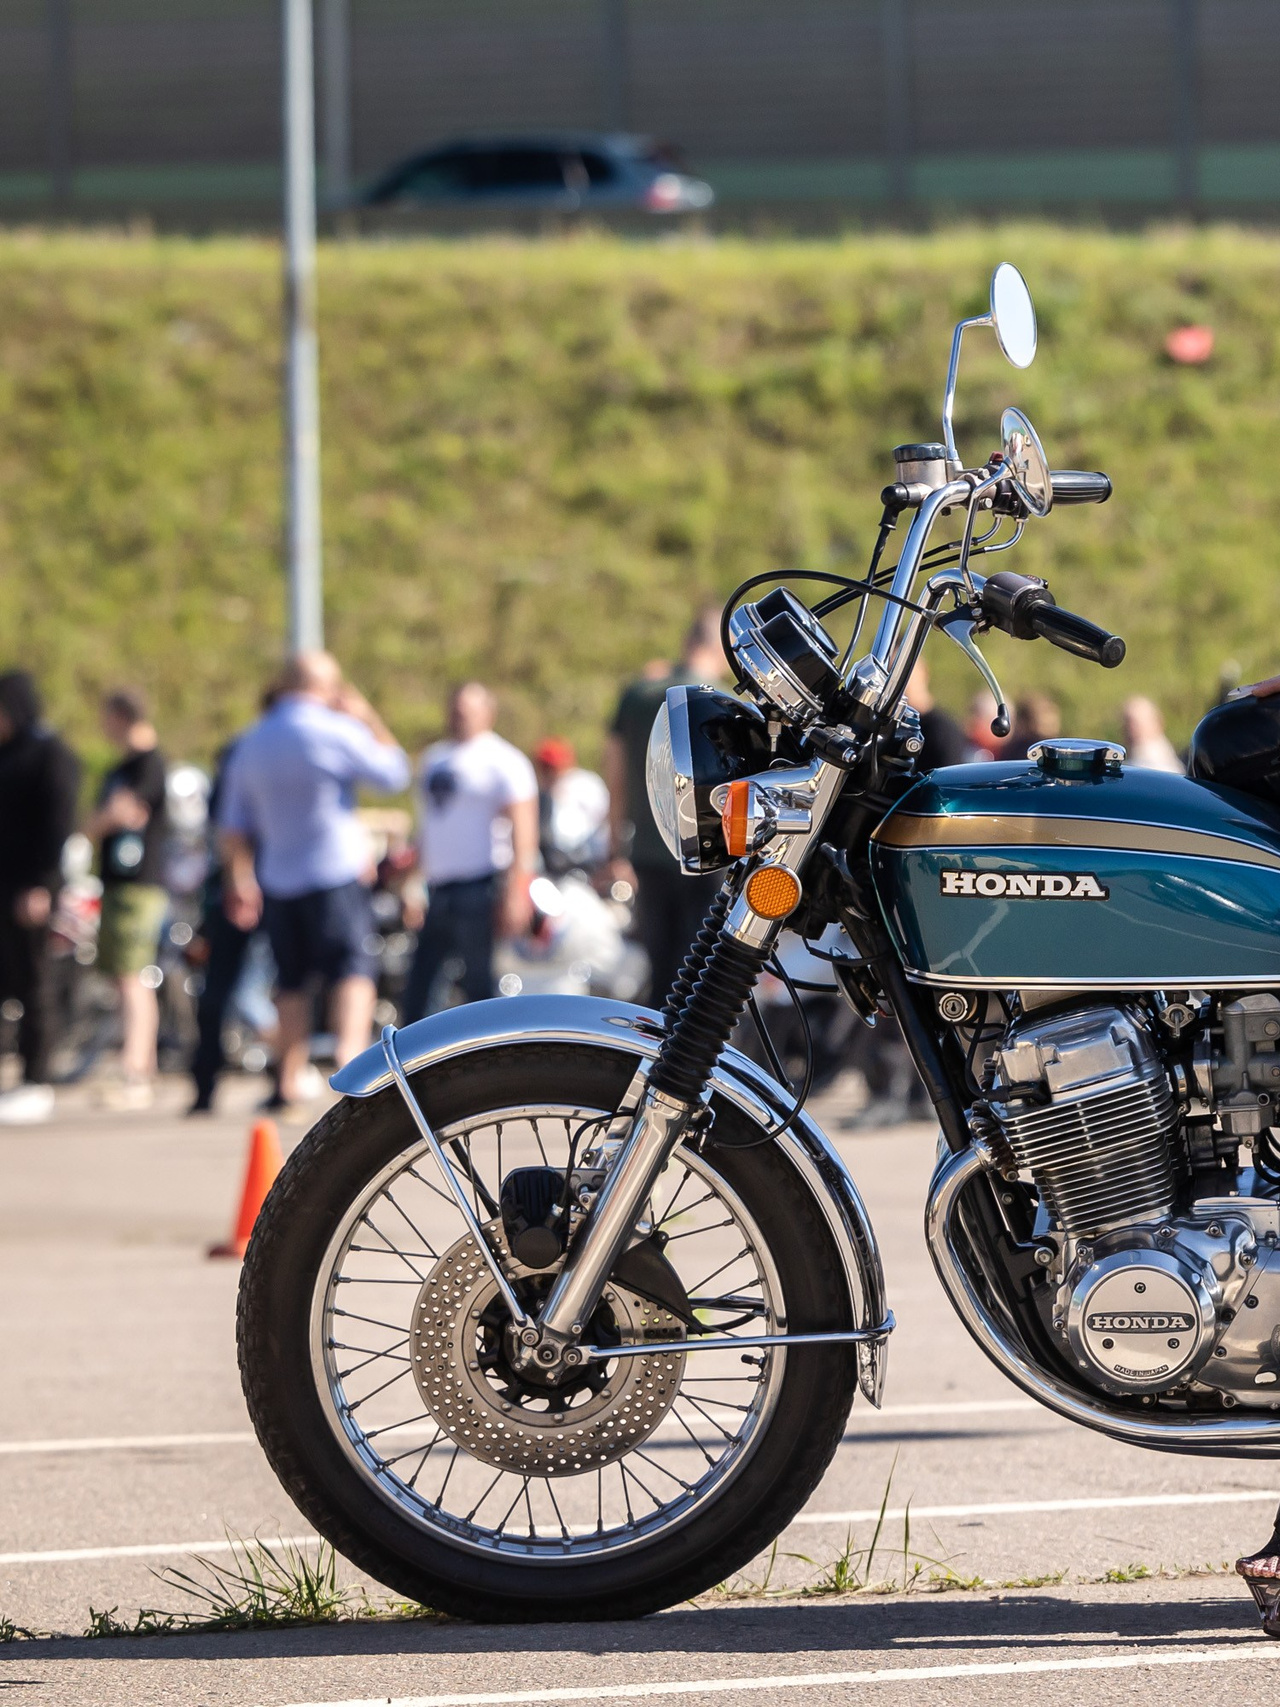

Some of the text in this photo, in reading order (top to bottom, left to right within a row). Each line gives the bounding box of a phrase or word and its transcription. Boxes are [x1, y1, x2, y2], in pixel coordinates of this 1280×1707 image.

[942, 871, 1106, 898] HONDA
[1092, 1316, 1189, 1329] HONDA
[1114, 1365, 1135, 1376] MADE
[1145, 1364, 1168, 1376] JAPAN
